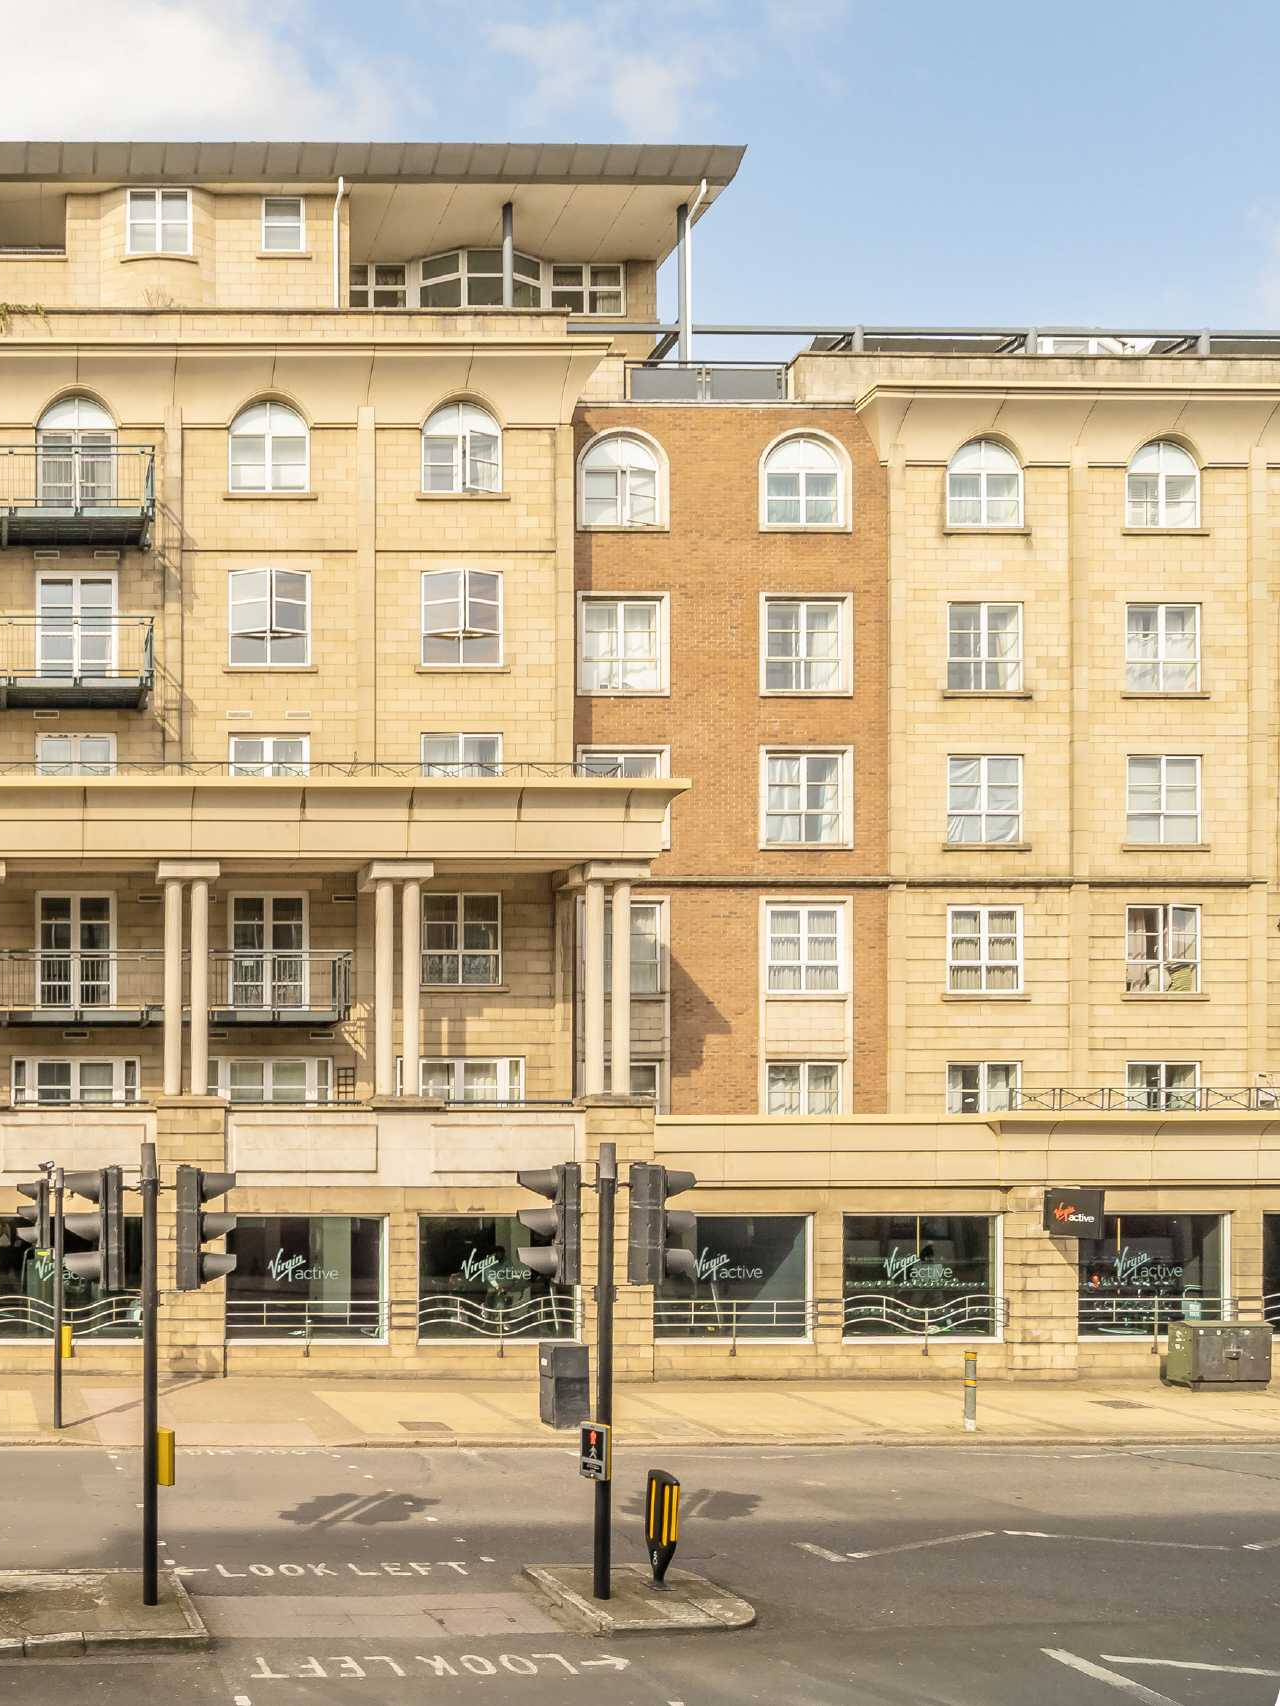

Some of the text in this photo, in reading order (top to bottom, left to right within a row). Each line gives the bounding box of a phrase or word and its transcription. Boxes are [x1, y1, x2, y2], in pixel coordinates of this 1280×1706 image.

[1068, 1213, 1095, 1223] active
[267, 1247, 339, 1282] Virgin active
[460, 1247, 532, 1283] Virgin active
[693, 1246, 764, 1280] Virgin active
[883, 1246, 953, 1280] Virgin active
[1113, 1246, 1183, 1279] Virgin active
[216, 1561, 470, 1577] LOOK LEFT
[250, 1653, 580, 1678] LOOK LEFT
